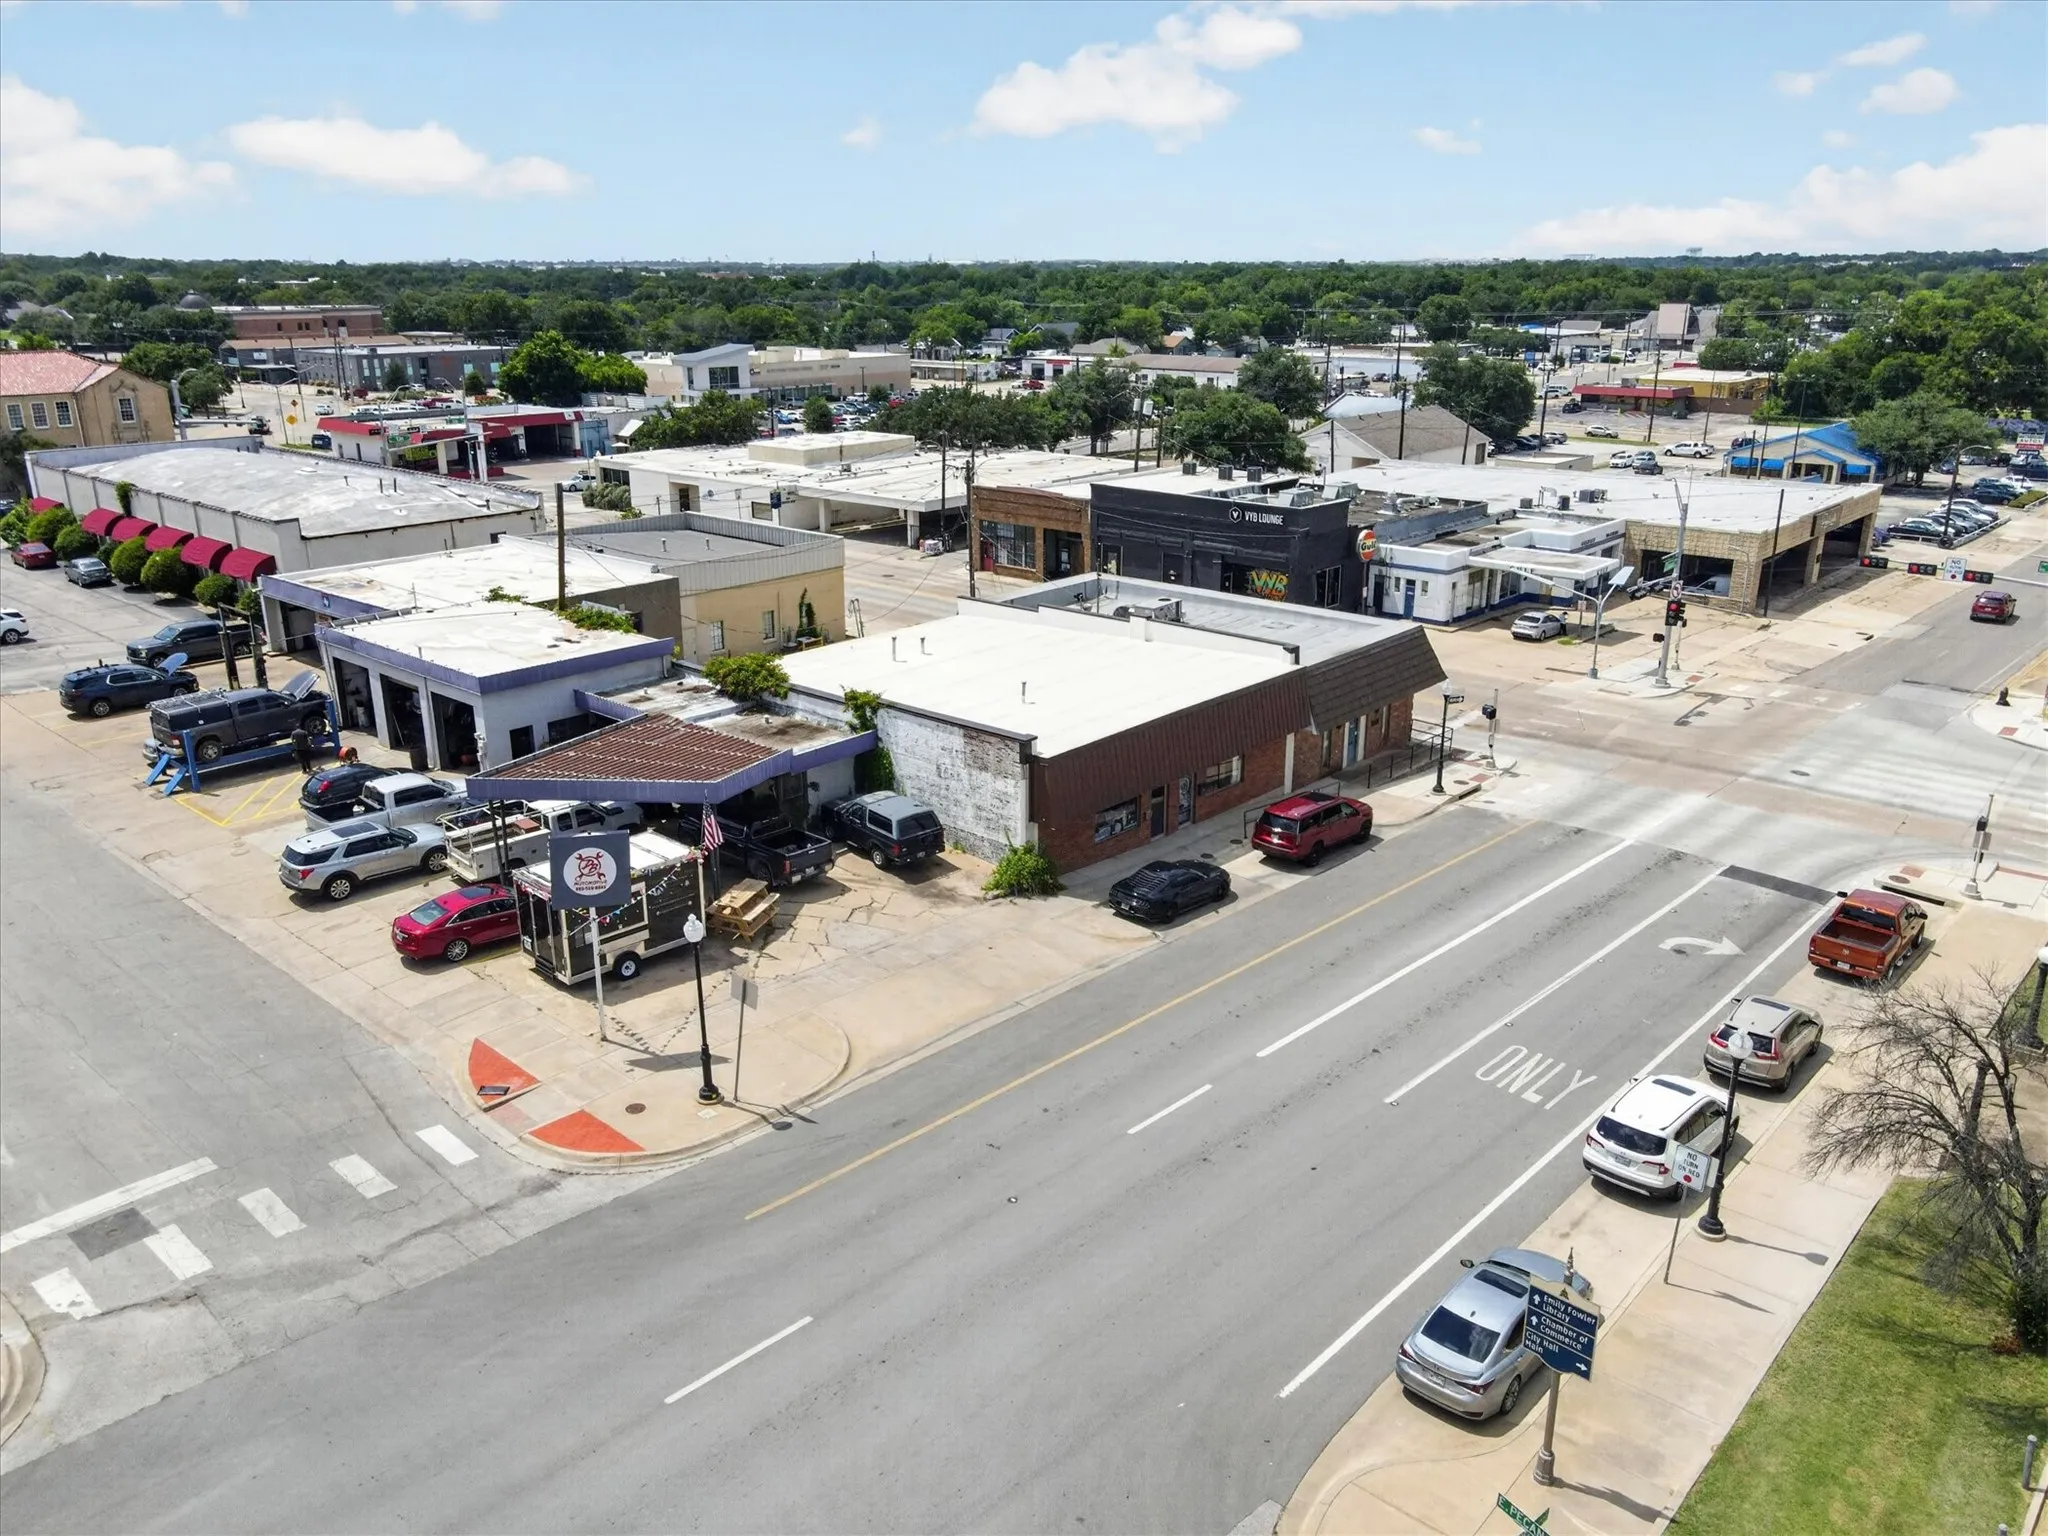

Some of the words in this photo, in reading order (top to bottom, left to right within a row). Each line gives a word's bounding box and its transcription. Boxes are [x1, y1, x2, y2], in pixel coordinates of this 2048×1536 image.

[1245, 511, 1258, 522] VYB
[1259, 513, 1284, 525] LOUNGE
[1475, 1045, 1598, 1110] ONLY
[1684, 1159, 1698, 1169] TURN
[1687, 1152, 1697, 1161] NO
[1678, 1164, 1686, 1172] ON
[1688, 1169, 1700, 1178] RED
[1543, 1295, 1566, 1312] Emily
[1568, 1306, 1595, 1325] Fowler
[1543, 1304, 1570, 1323] Library
[1540, 1325, 1582, 1351] Commerce
[1541, 1316, 1577, 1338] Chamber
[1579, 1336, 1588, 1345] of
[1525, 1339, 1544, 1354] Main
[1526, 1331, 1541, 1344] City
[1543, 1340, 1559, 1353] Hall
[1499, 1496, 1509, 1512] E.
